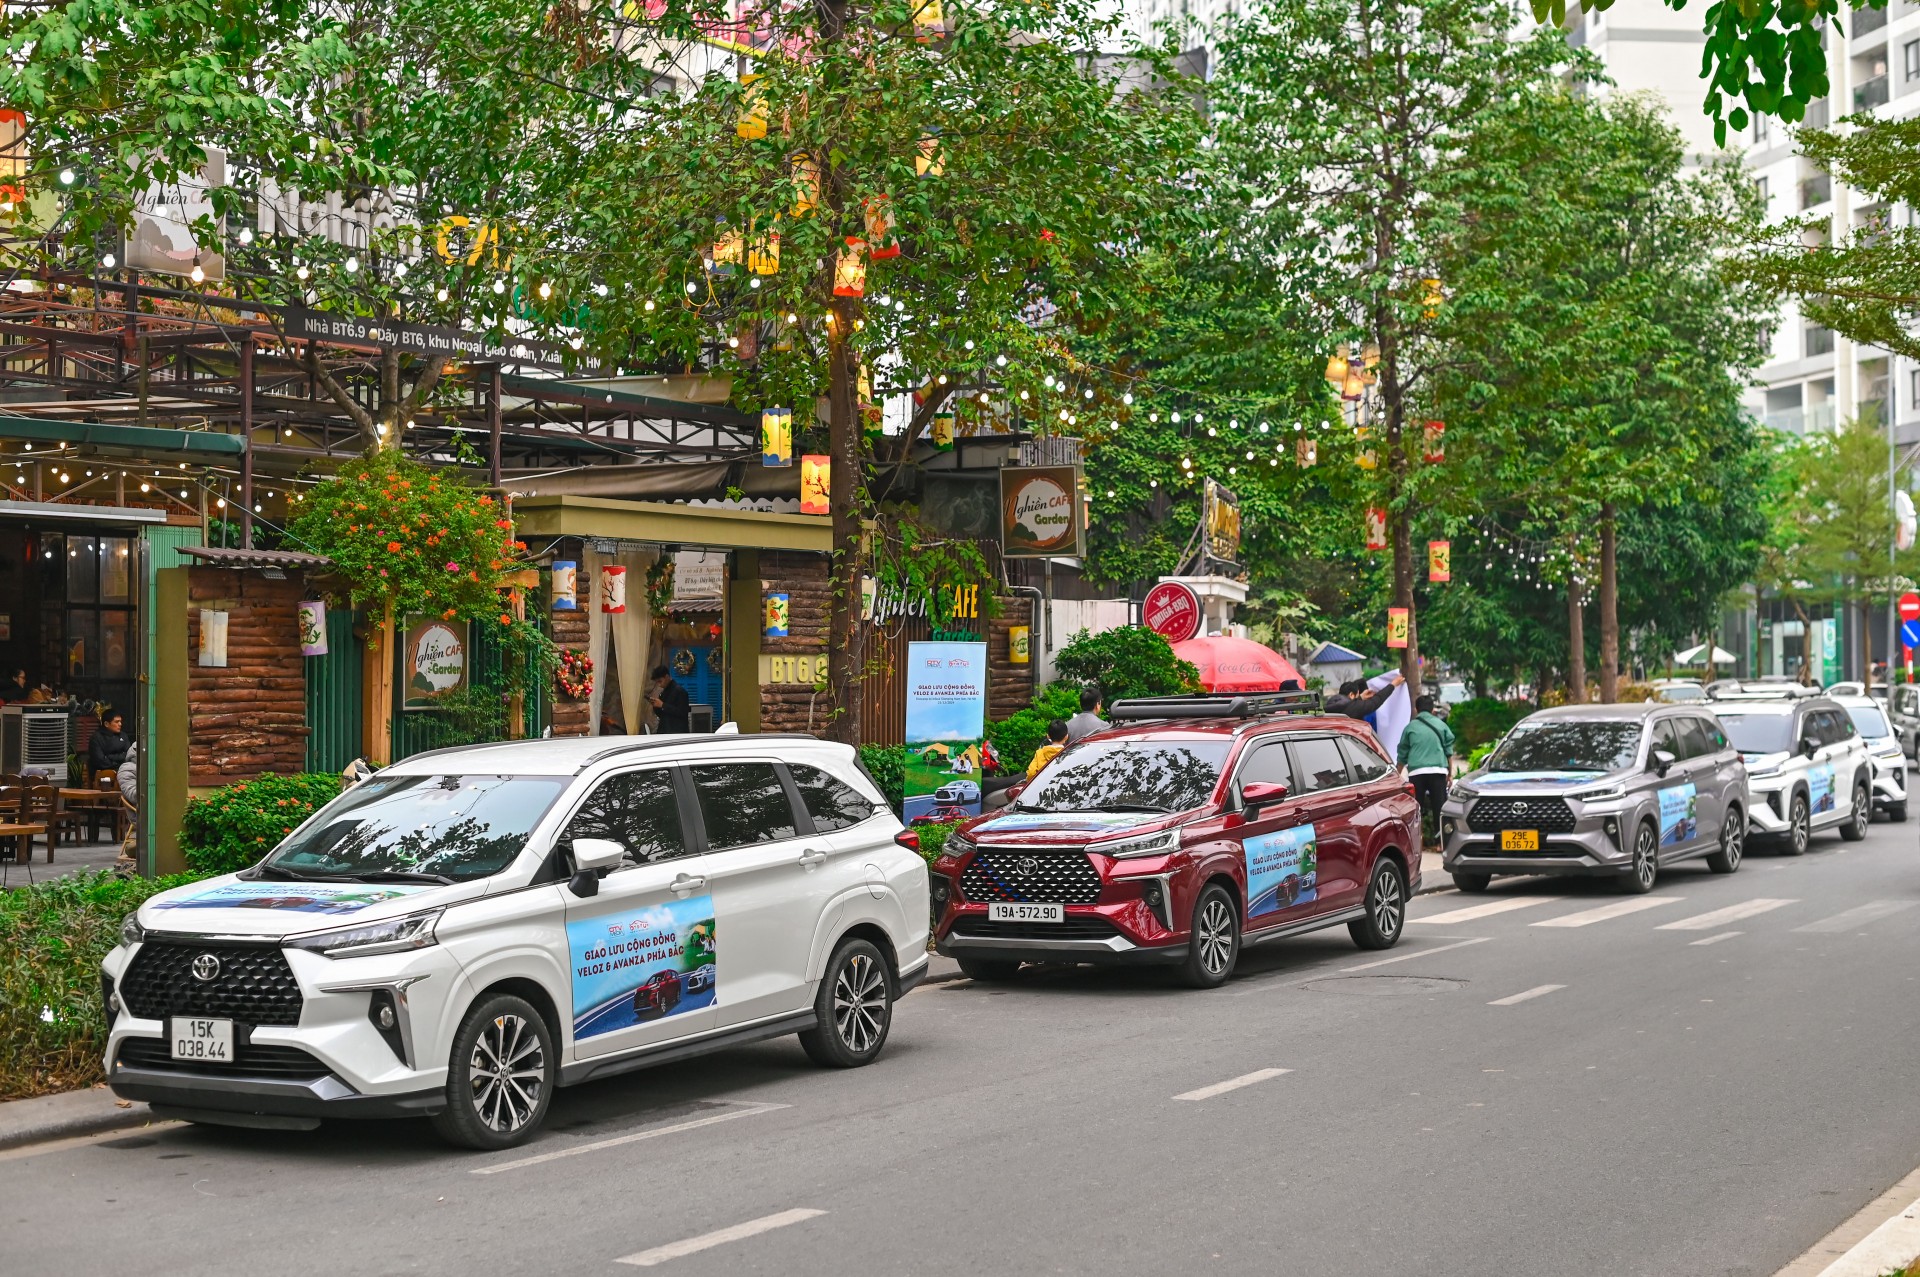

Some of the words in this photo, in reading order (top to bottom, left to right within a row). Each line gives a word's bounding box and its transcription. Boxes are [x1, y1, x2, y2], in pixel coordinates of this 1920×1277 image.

[304, 318, 329, 334] Nhà
[332, 321, 366, 339] BT6.9
[377, 328, 399, 346] Dãy
[402, 330, 426, 349] BT6,
[428, 333, 450, 350] khu
[452, 337, 482, 357] Ngoại
[484, 343, 507, 358] giao
[1004, 495, 1048, 519] Nghiền
[1034, 513, 1069, 525] Garden
[432, 663, 463, 675] Garden
[771, 656, 828, 683] BT6.9
[943, 683, 960, 691] CỘNG
[1512, 831, 1528, 840] 29E
[1253, 856, 1264, 866] GIAO
[1273, 851, 1285, 862] CỘNG
[1266, 862, 1282, 872] AVANZA
[584, 947, 607, 961] GIAO
[608, 943, 625, 956] LƯU
[626, 938, 651, 954] CỘNG
[653, 931, 676, 946] ĐỒNG
[577, 963, 604, 978] VELOZ
[605, 962, 611, 971] &
[613, 954, 646, 971] AVANZA
[647, 948, 667, 963] PHÍA
[668, 942, 685, 957] BẮC
[190, 1020, 215, 1039] 15K
[178, 1039, 226, 1059] 038.44
